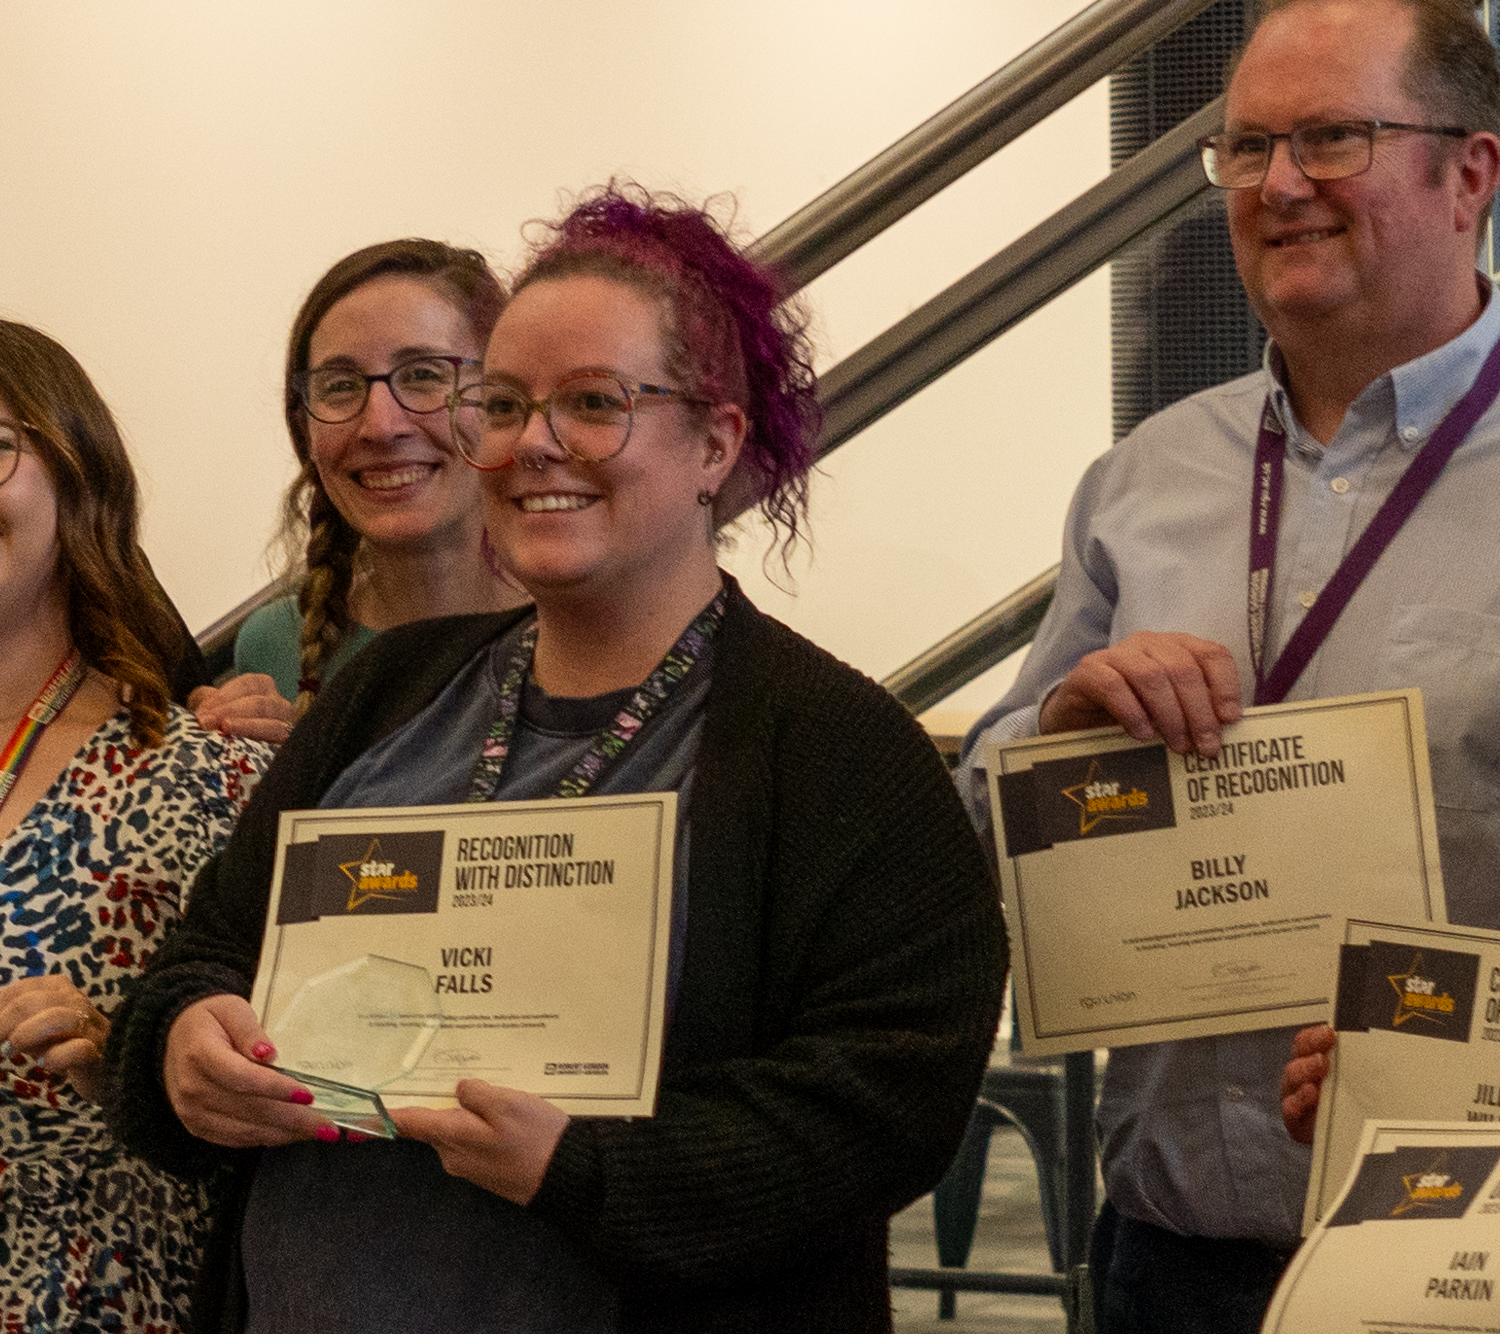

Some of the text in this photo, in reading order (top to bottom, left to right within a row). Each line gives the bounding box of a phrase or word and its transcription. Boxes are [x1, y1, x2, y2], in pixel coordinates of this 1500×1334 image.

[1085, 781, 1120, 797] star
[1187, 760, 1345, 803] OF RECOGNITION
[1085, 789, 1148, 813] awards
[457, 833, 574, 861] RECOGNITION
[360, 861, 395, 876] star
[455, 860, 614, 890] WITH DISTINCTION
[1190, 855, 1246, 881] BILLY
[359, 872, 418, 890] awards
[1175, 880, 1269, 910] JACKSON
[441, 947, 492, 968] VICKI
[435, 974, 493, 994] FALLS
[1404, 974, 1435, 996] star
[1404, 990, 1455, 1013] awards
[1410, 1182, 1463, 1200] awards
[1416, 1171, 1450, 1190] star
[1449, 1251, 1489, 1272] IAIN
[1425, 1278, 1494, 1301] PARKIN
